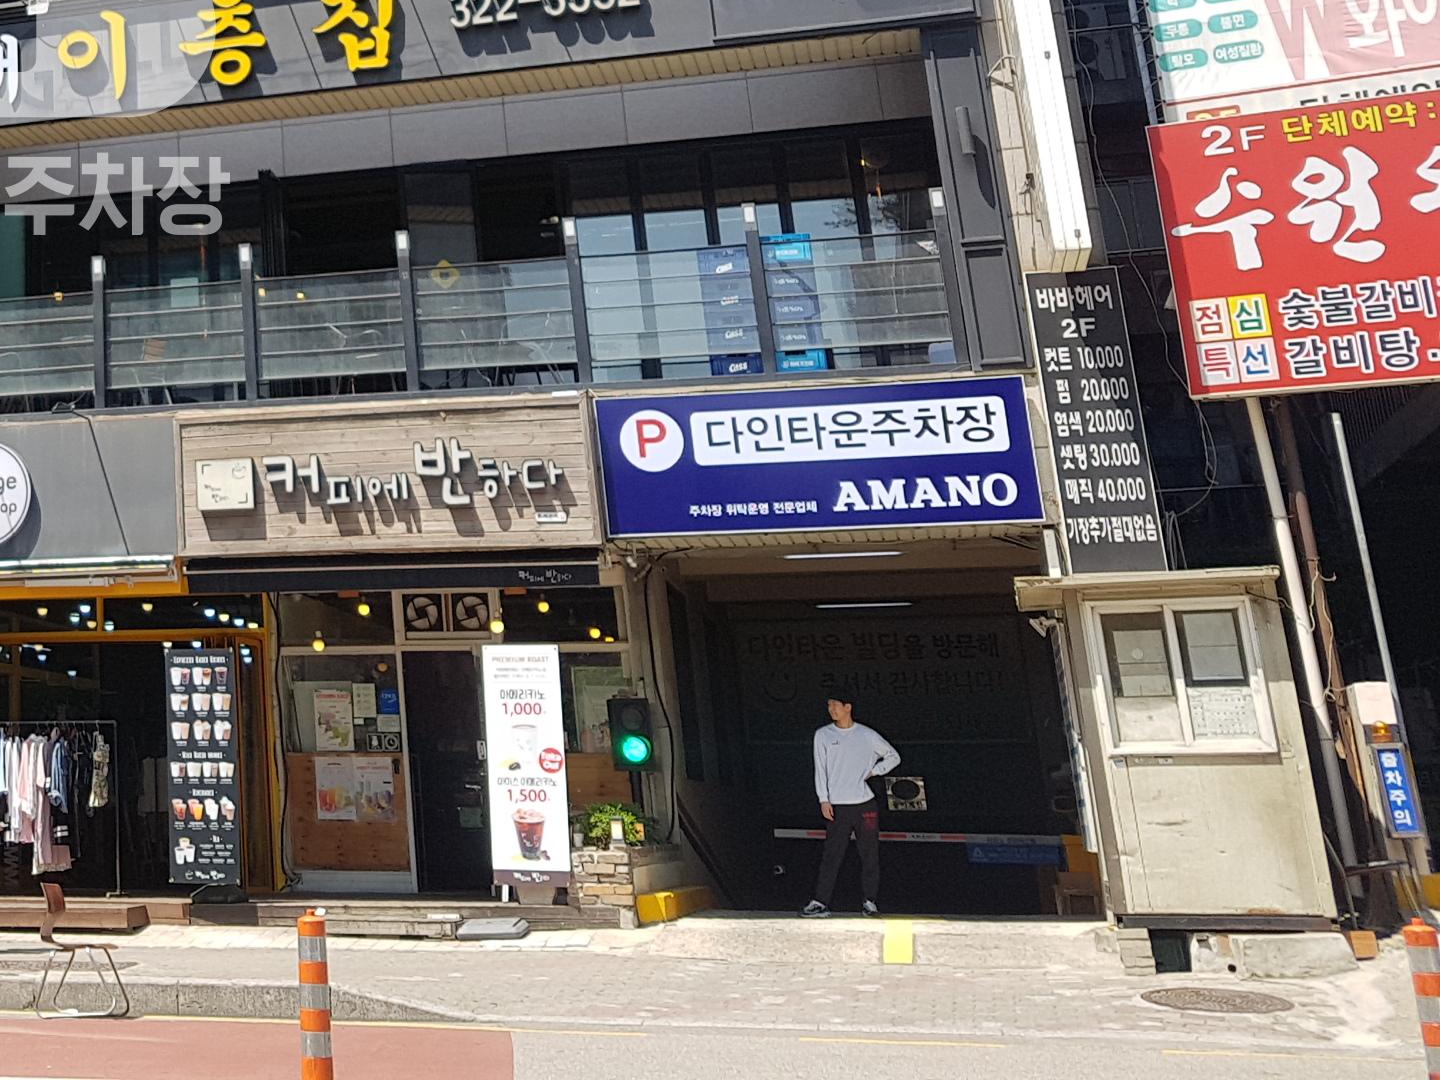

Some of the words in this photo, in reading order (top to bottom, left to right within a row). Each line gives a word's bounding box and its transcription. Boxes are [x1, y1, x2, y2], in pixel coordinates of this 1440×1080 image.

[1200, 124, 1266, 157] 2F
[1281, 99, 1419, 144] 단체예약
[1035, 283, 1114, 313] 바바헤어
[1279, 277, 1440, 330] 숯불갈비
[1061, 317, 1096, 339] 2F
[1285, 327, 1420, 379] 갈비탕
[635, 418, 667, 458] P
[706, 401, 997, 455] 다인타운주차장
[1054, 410, 1084, 437] 염색
[833, 472, 1019, 513] AMANO
[689, 503, 723, 518] 주차장
[502, 702, 543, 717] 1,000
[507, 788, 548, 803] 1,500
